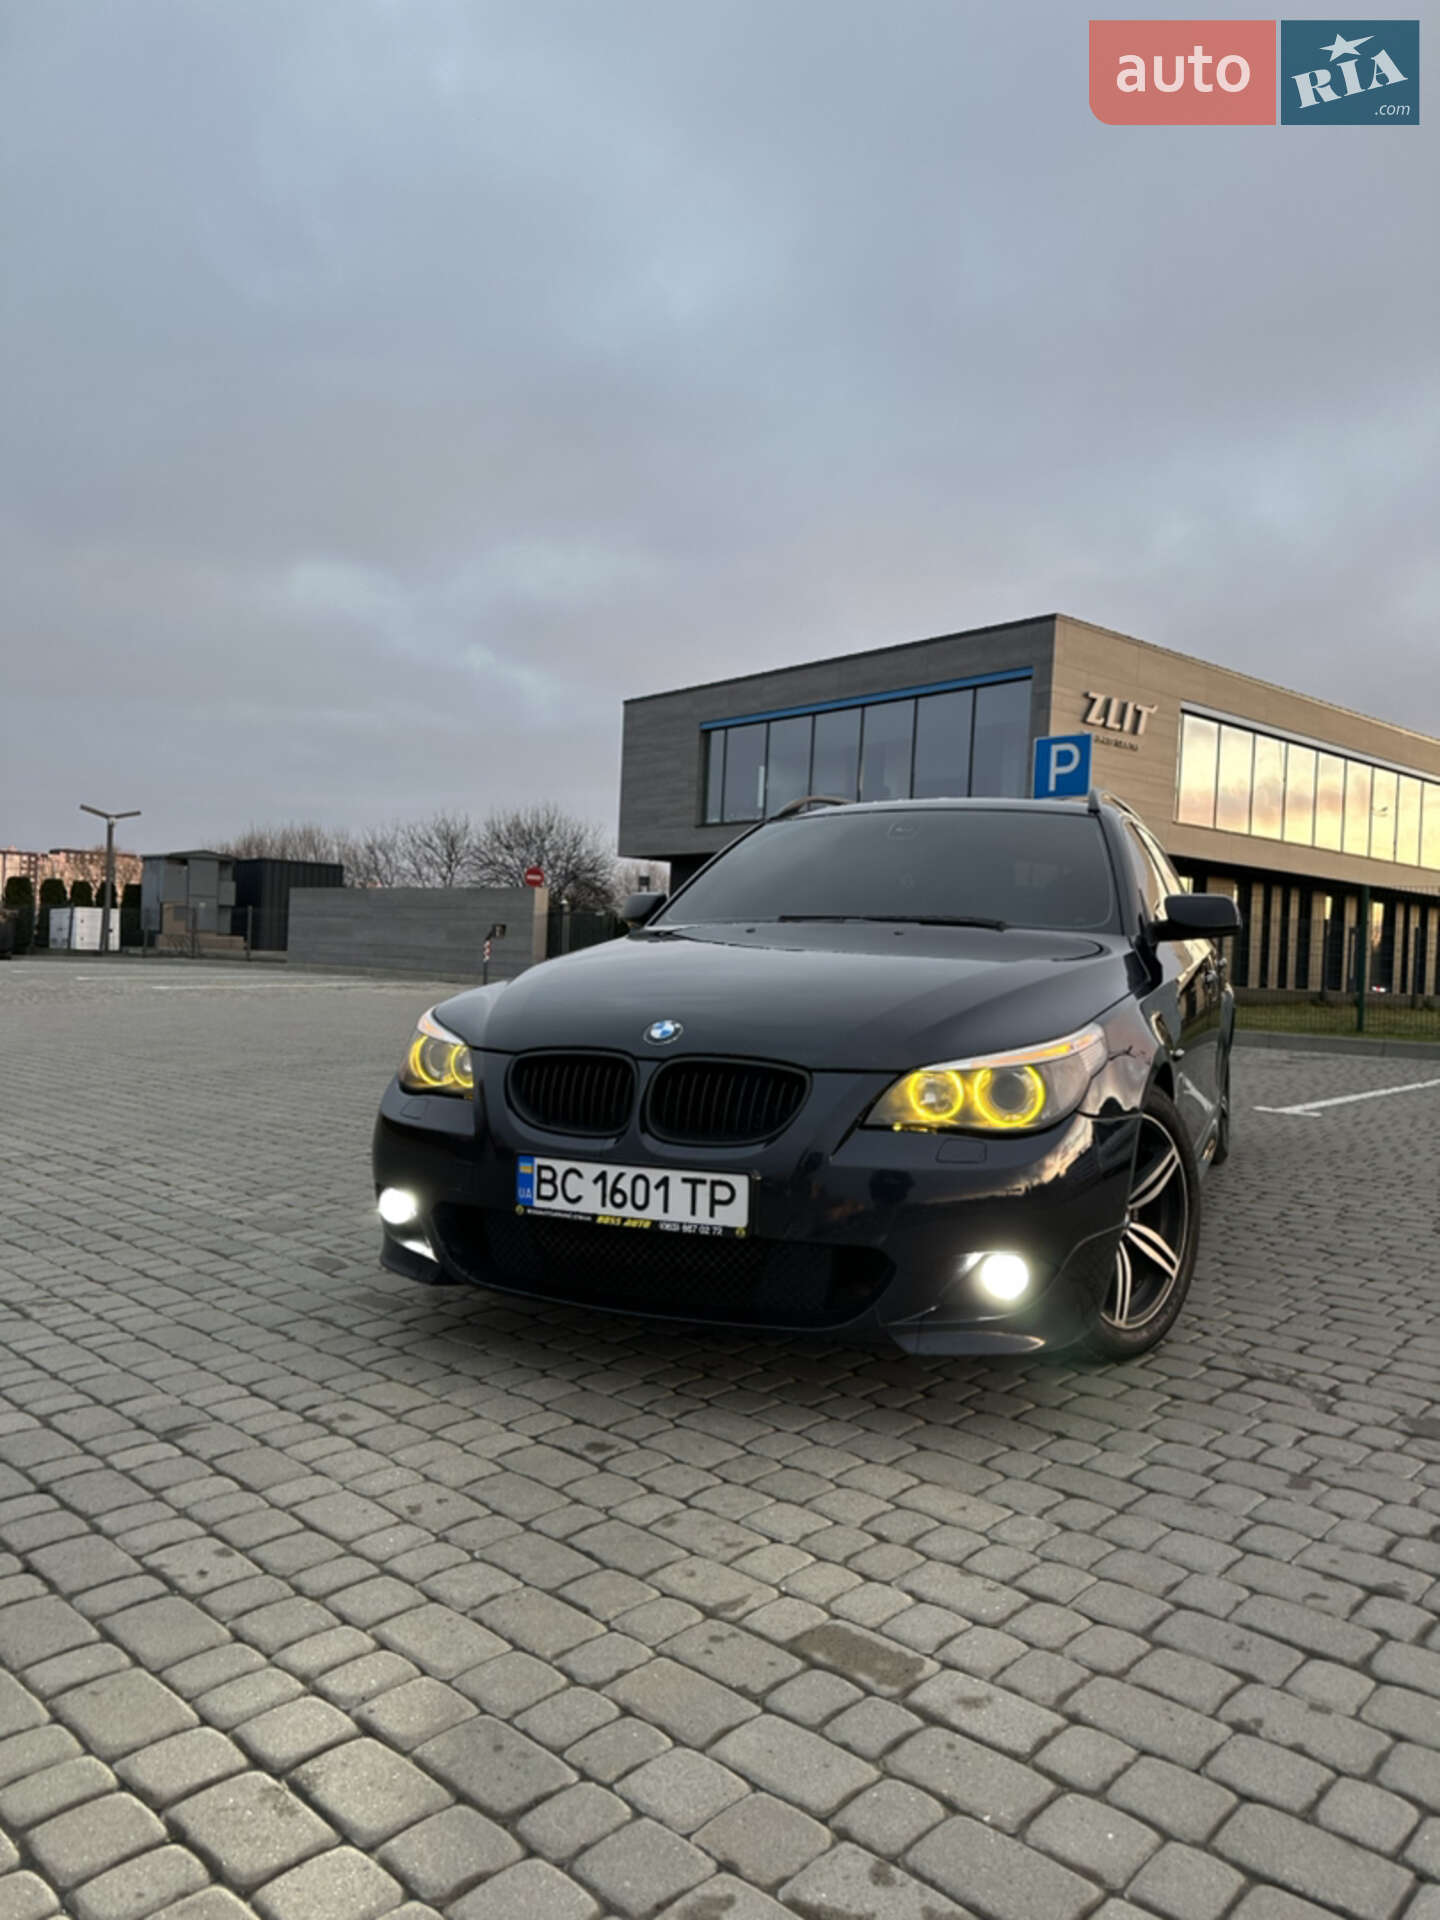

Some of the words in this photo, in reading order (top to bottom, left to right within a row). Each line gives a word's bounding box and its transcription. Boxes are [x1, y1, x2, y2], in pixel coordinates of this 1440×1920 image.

[1083, 691, 1158, 735] ZLIT
[1048, 743, 1081, 792] P
[518, 1188, 532, 1199] UA
[536, 1164, 584, 1204] BC
[592, 1170, 670, 1214] 1601
[681, 1178, 737, 1218] TP
